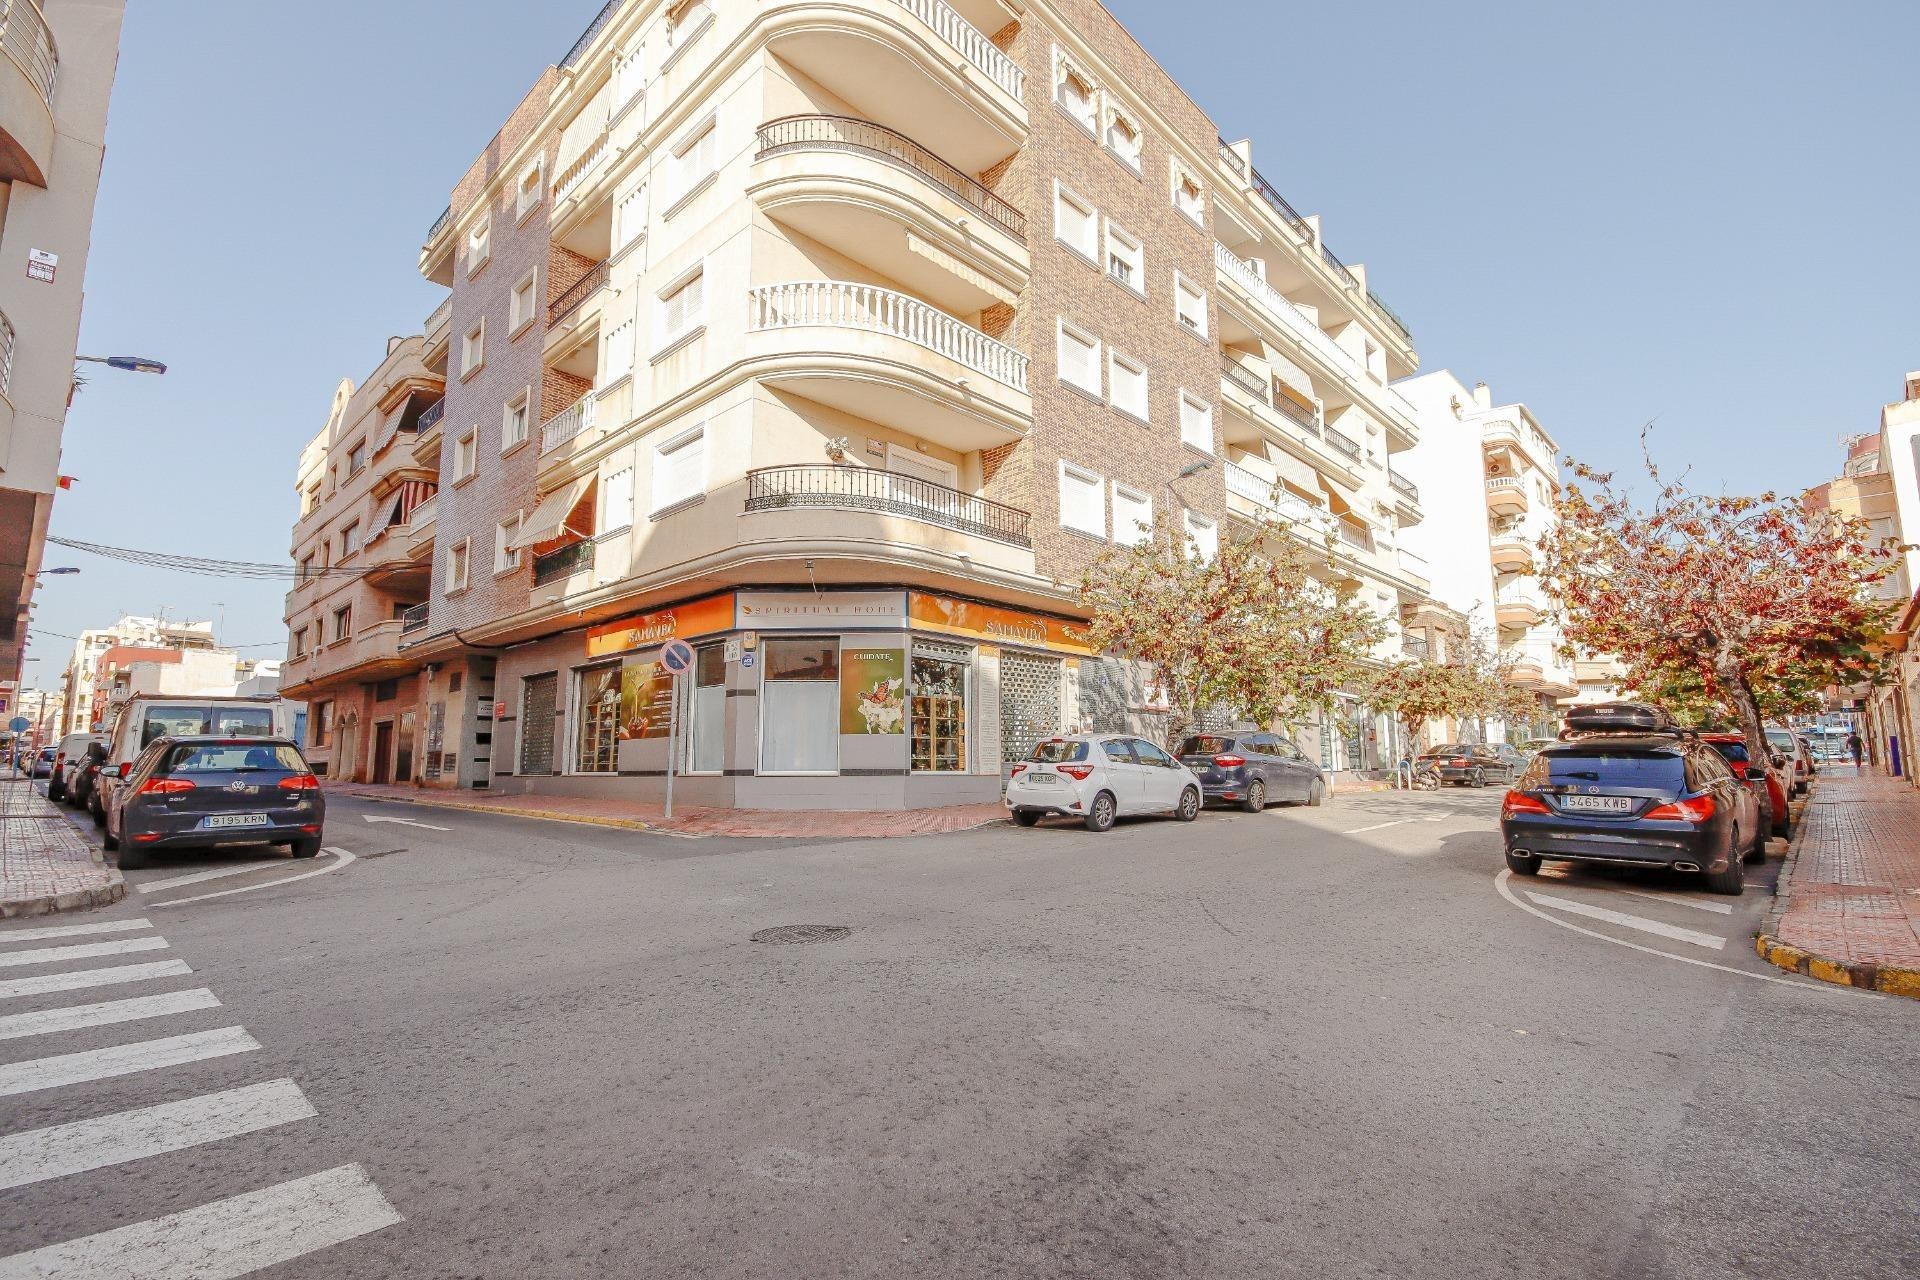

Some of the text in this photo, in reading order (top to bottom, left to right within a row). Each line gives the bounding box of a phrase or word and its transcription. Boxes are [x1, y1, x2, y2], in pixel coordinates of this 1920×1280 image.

[1569, 797, 1628, 809] 5465 KWB
[212, 815, 265, 826] 9195 KRN
